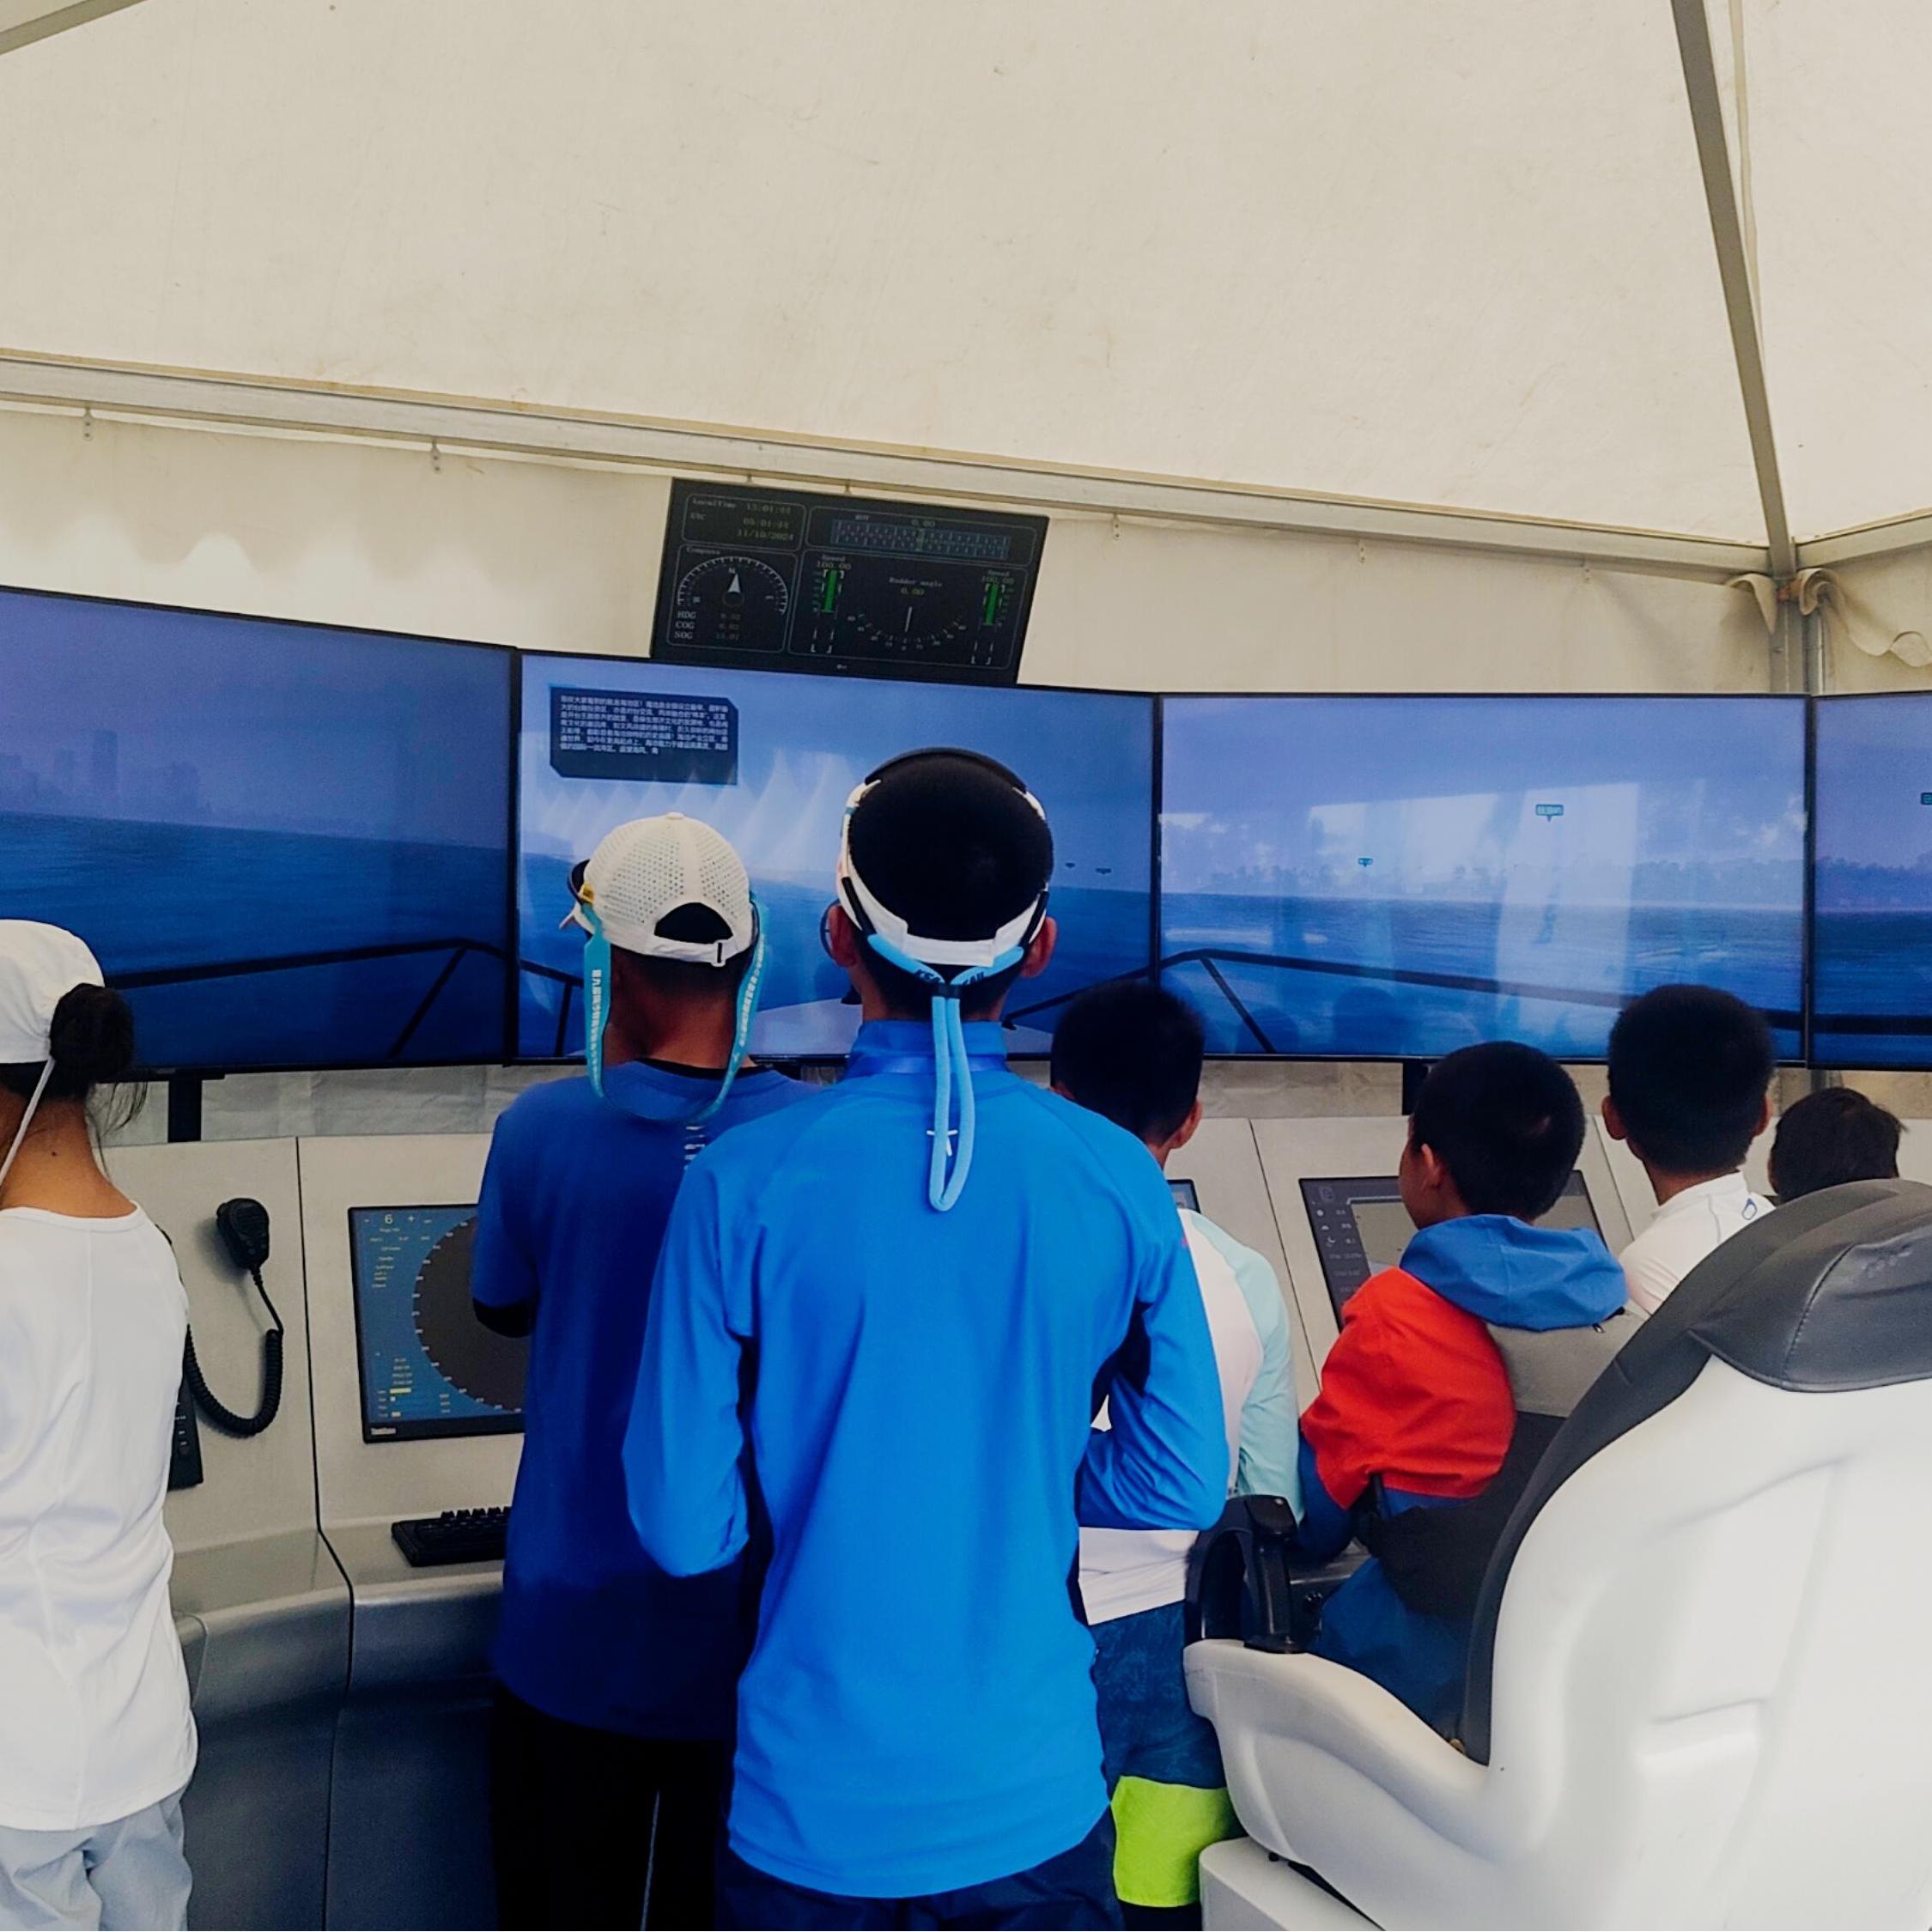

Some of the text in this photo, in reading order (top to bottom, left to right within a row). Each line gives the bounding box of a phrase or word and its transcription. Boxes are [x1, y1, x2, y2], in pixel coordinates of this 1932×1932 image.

[677, 611, 696, 619] HDG
[675, 621, 695, 629] COG
[674, 631, 693, 640] SOG
[384, 1213, 393, 1224] 6
